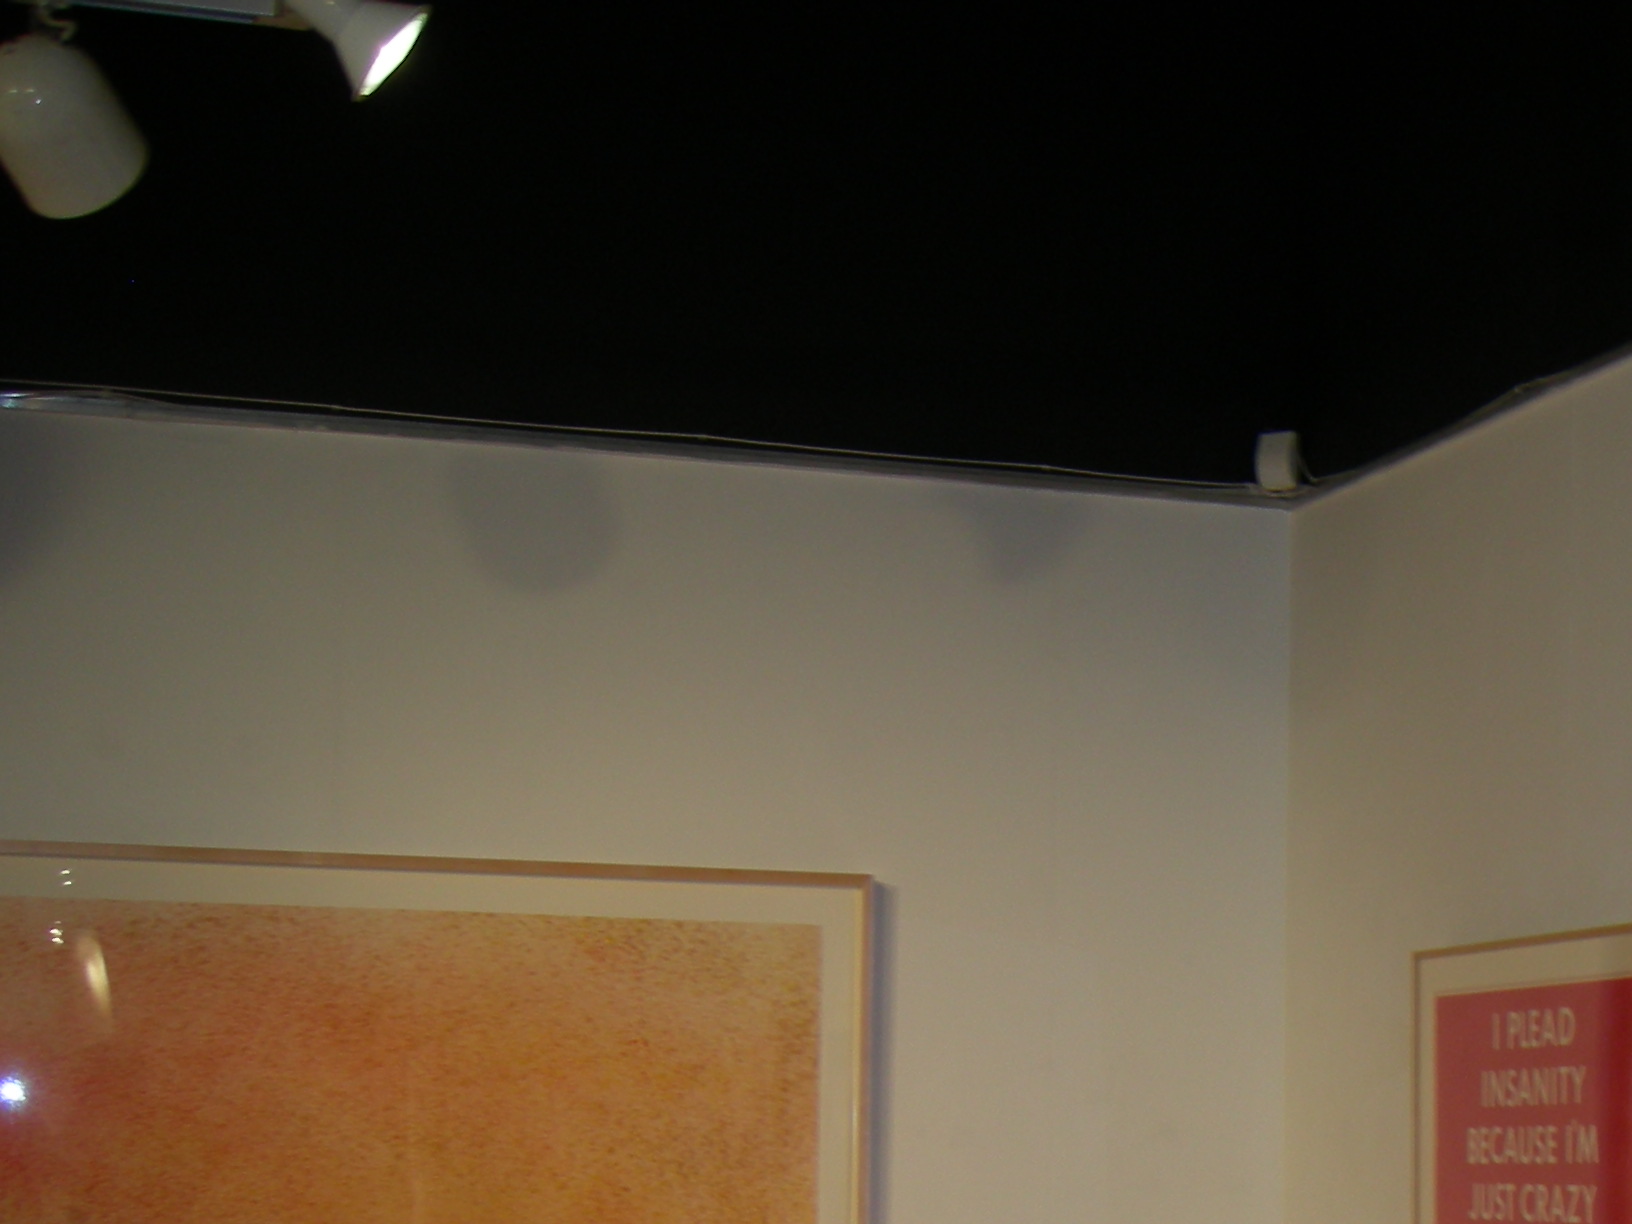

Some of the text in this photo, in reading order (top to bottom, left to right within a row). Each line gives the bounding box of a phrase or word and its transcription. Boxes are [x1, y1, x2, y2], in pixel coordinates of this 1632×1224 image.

[1492, 1006, 1576, 1050] I PLEAD
[1480, 1065, 1586, 1108] INSANITY
[1465, 1119, 1599, 1166] BECAUSE I'M
[1467, 1182, 1598, 1224] JUST CRAZY
